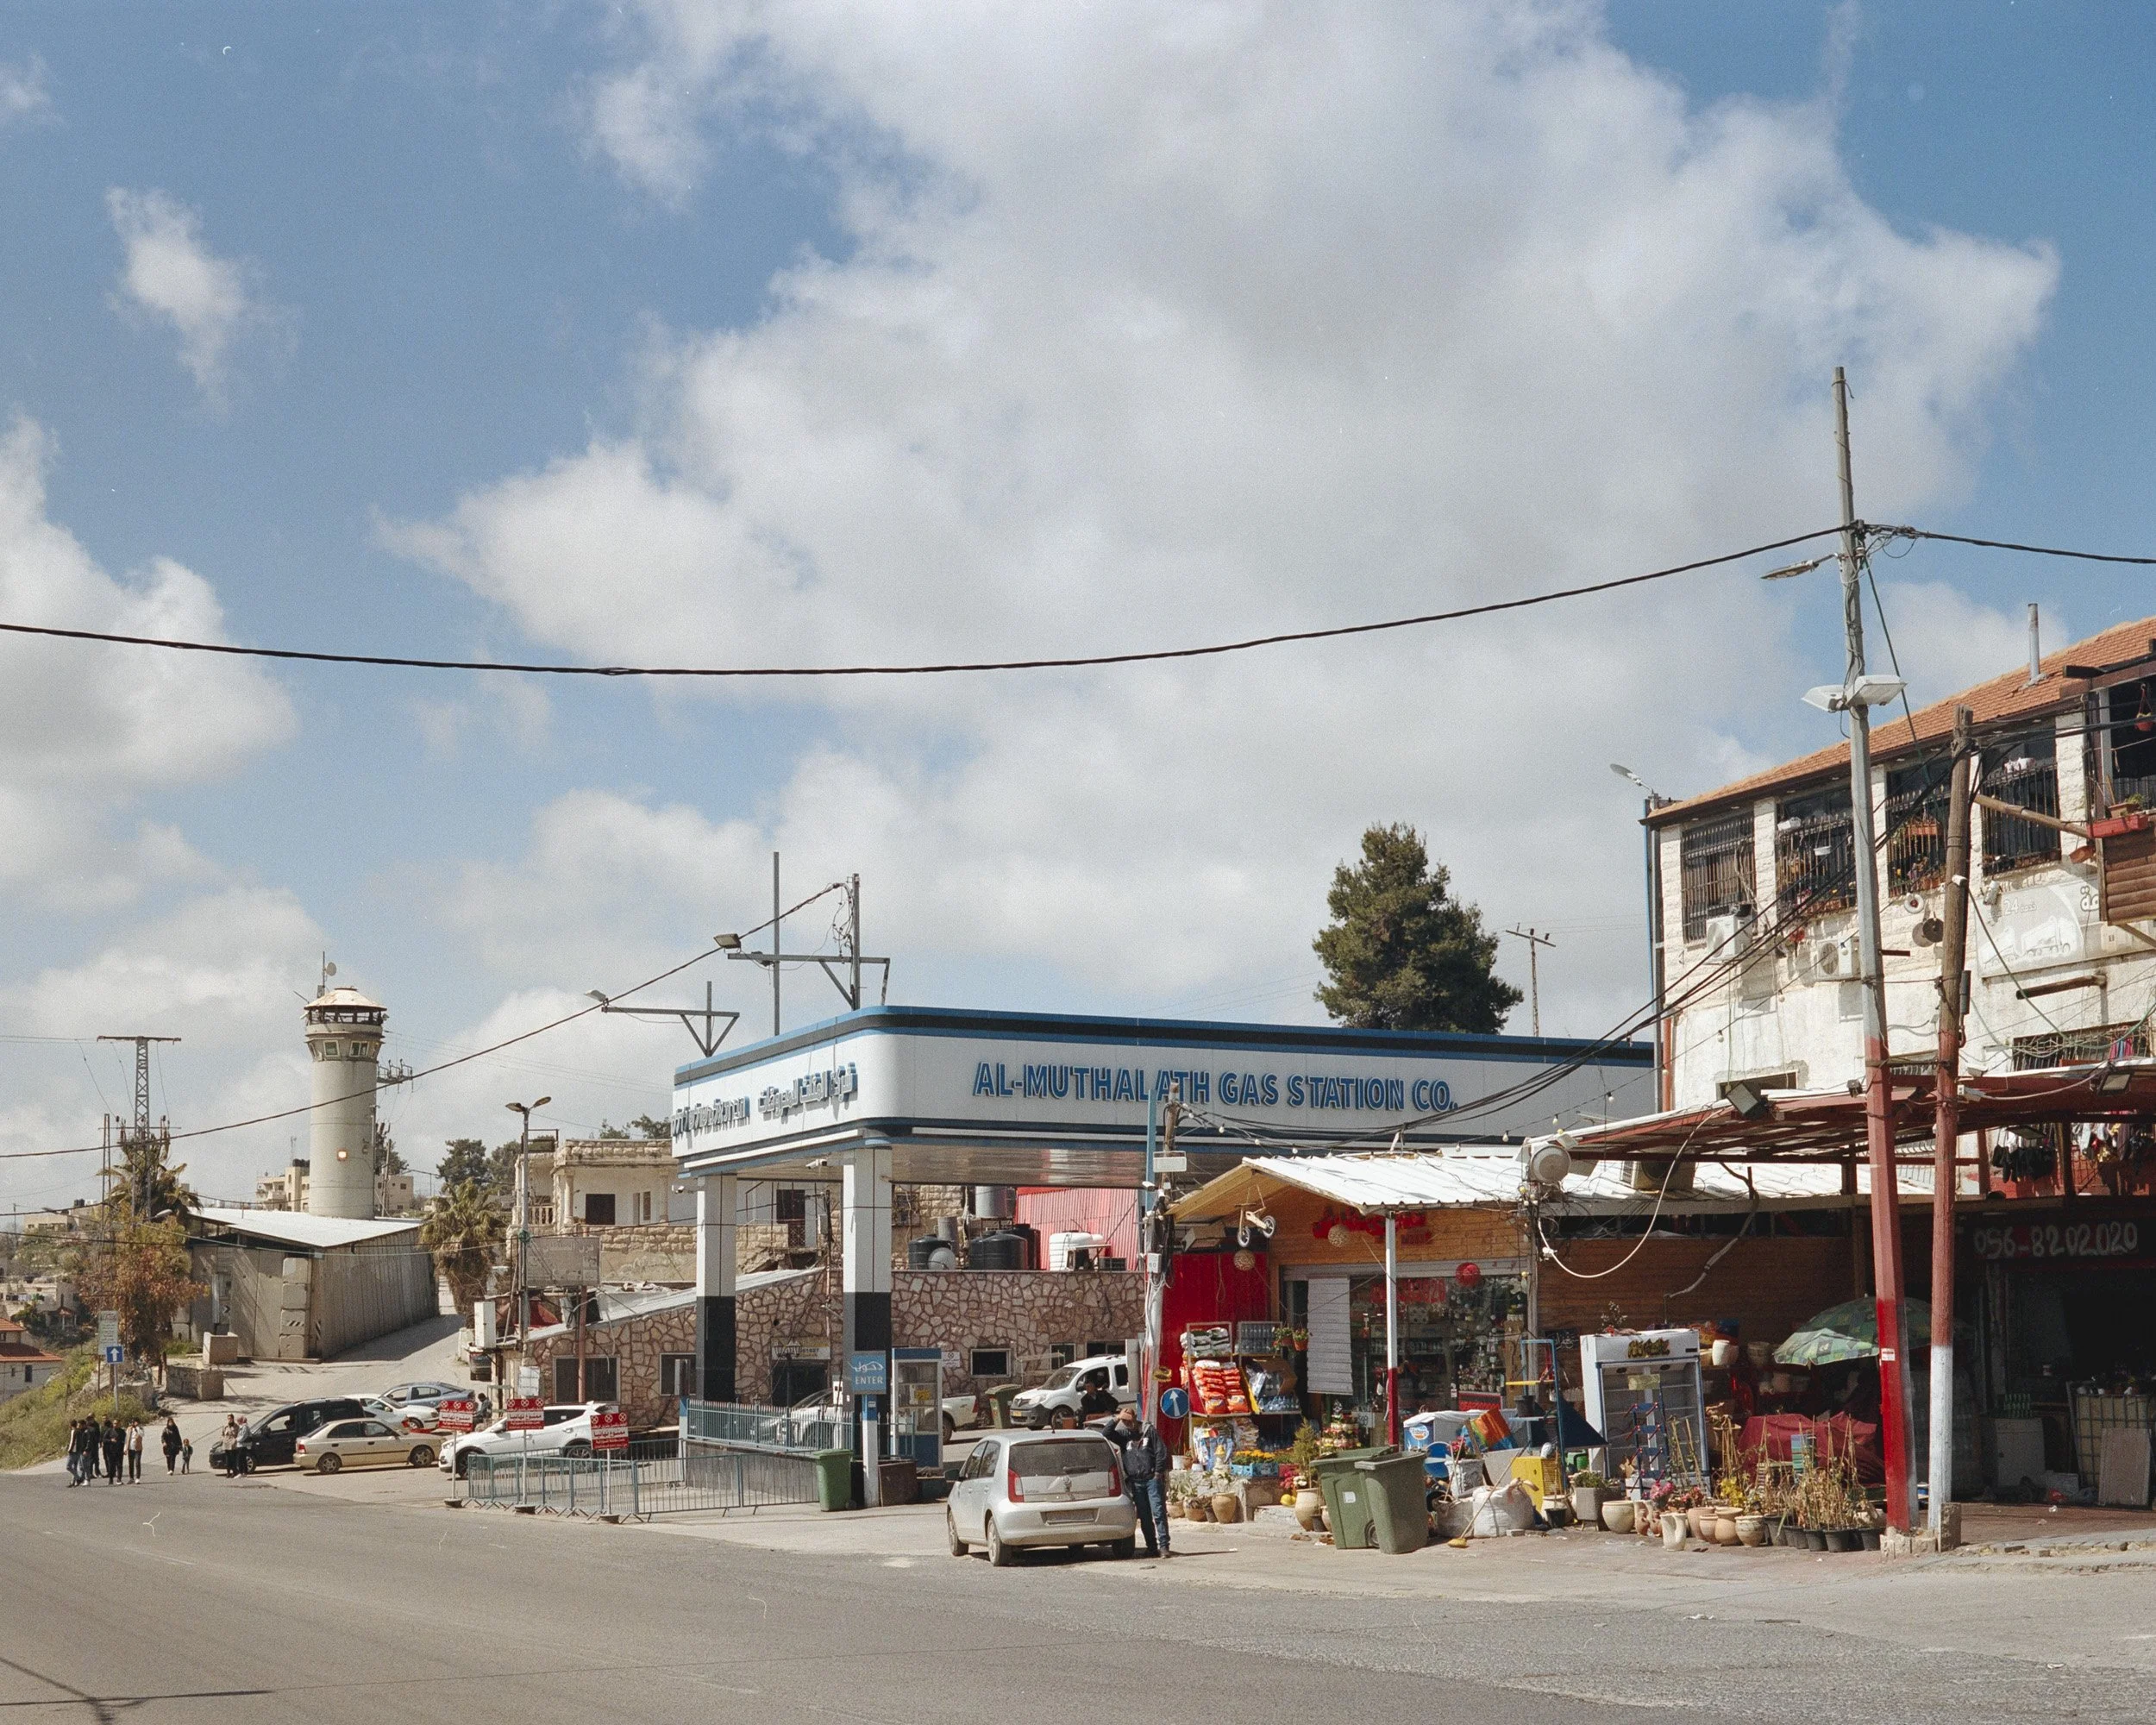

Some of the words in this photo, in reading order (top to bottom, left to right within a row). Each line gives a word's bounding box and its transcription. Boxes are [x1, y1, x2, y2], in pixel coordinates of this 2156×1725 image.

[2002, 898, 2019, 916] 24
[829, 1062, 858, 1102] شركة
[974, 1062, 1210, 1103] AL-MUTHALATH
[1219, 1072, 1279, 1106] GAS
[1288, 1075, 1405, 1111] STATION
[1973, 1220, 2138, 1260] 056-8202020
[855, 1376, 884, 1385] ENTER
